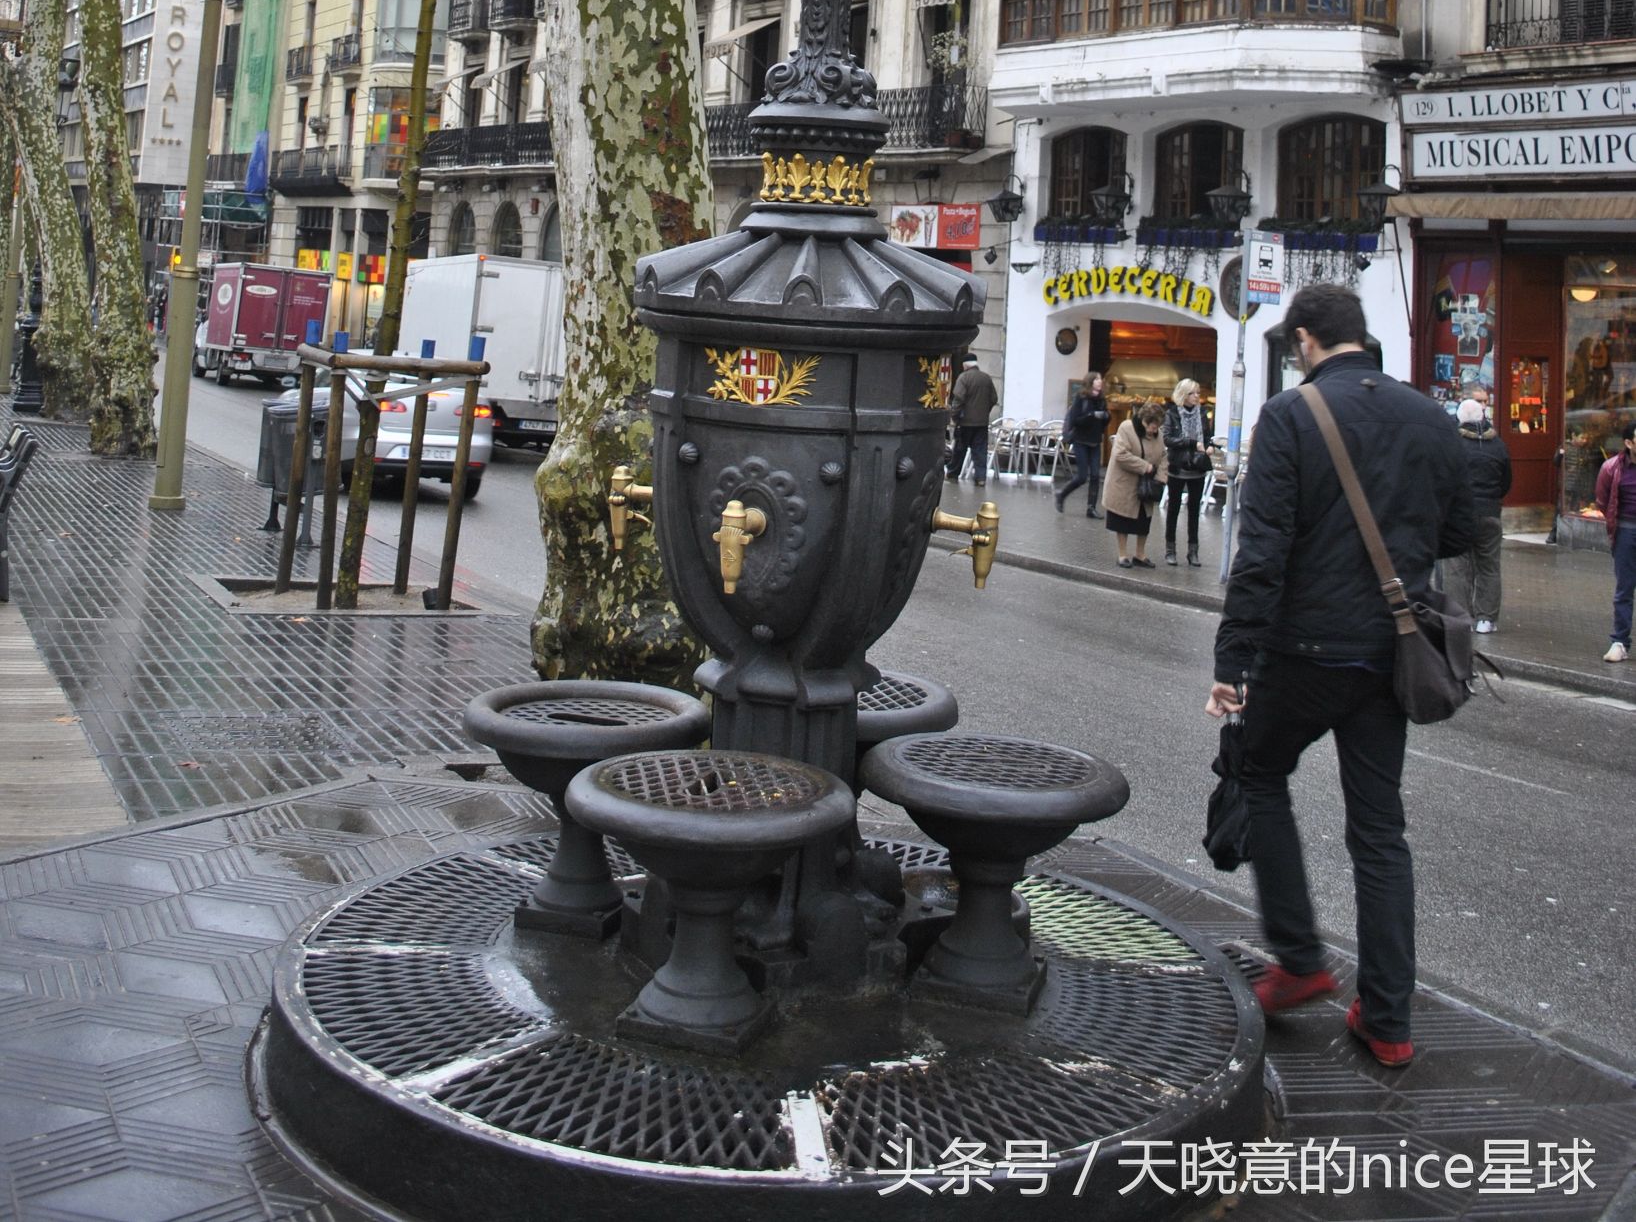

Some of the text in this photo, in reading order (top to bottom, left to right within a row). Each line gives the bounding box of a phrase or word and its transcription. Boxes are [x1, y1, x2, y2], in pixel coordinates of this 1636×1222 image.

[161, 6, 185, 128] ROYAL
[1414, 101, 1434, 116] 129
[1447, 96, 1463, 117] I.
[1470, 90, 1567, 116] LLOBET
[1576, 88, 1591, 111] Y
[1426, 137, 1549, 168] MUSICAL
[1042, 265, 1216, 317] CERVECERIA
